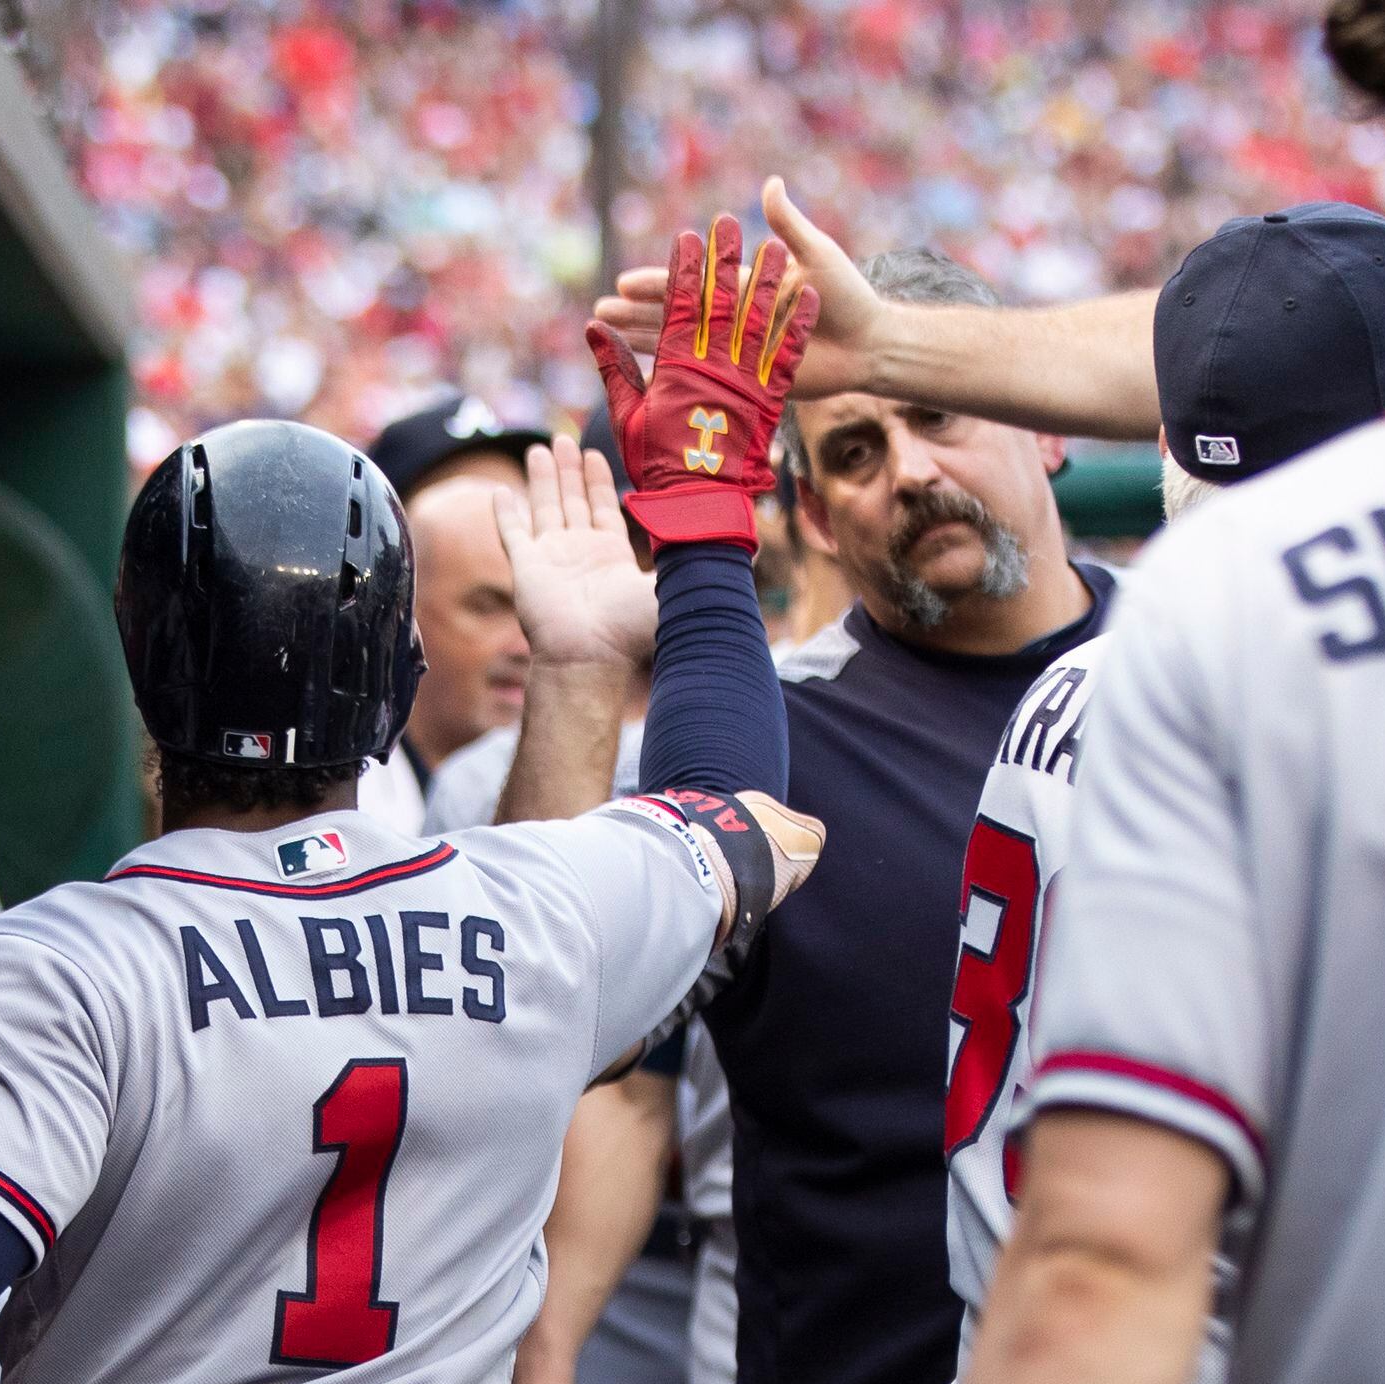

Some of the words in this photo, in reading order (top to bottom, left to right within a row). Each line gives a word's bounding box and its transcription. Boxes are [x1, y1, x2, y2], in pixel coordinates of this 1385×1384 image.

[285, 727, 297, 764] 1
[179, 910, 508, 1033] ALBIES
[270, 1056, 409, 1370] 1
